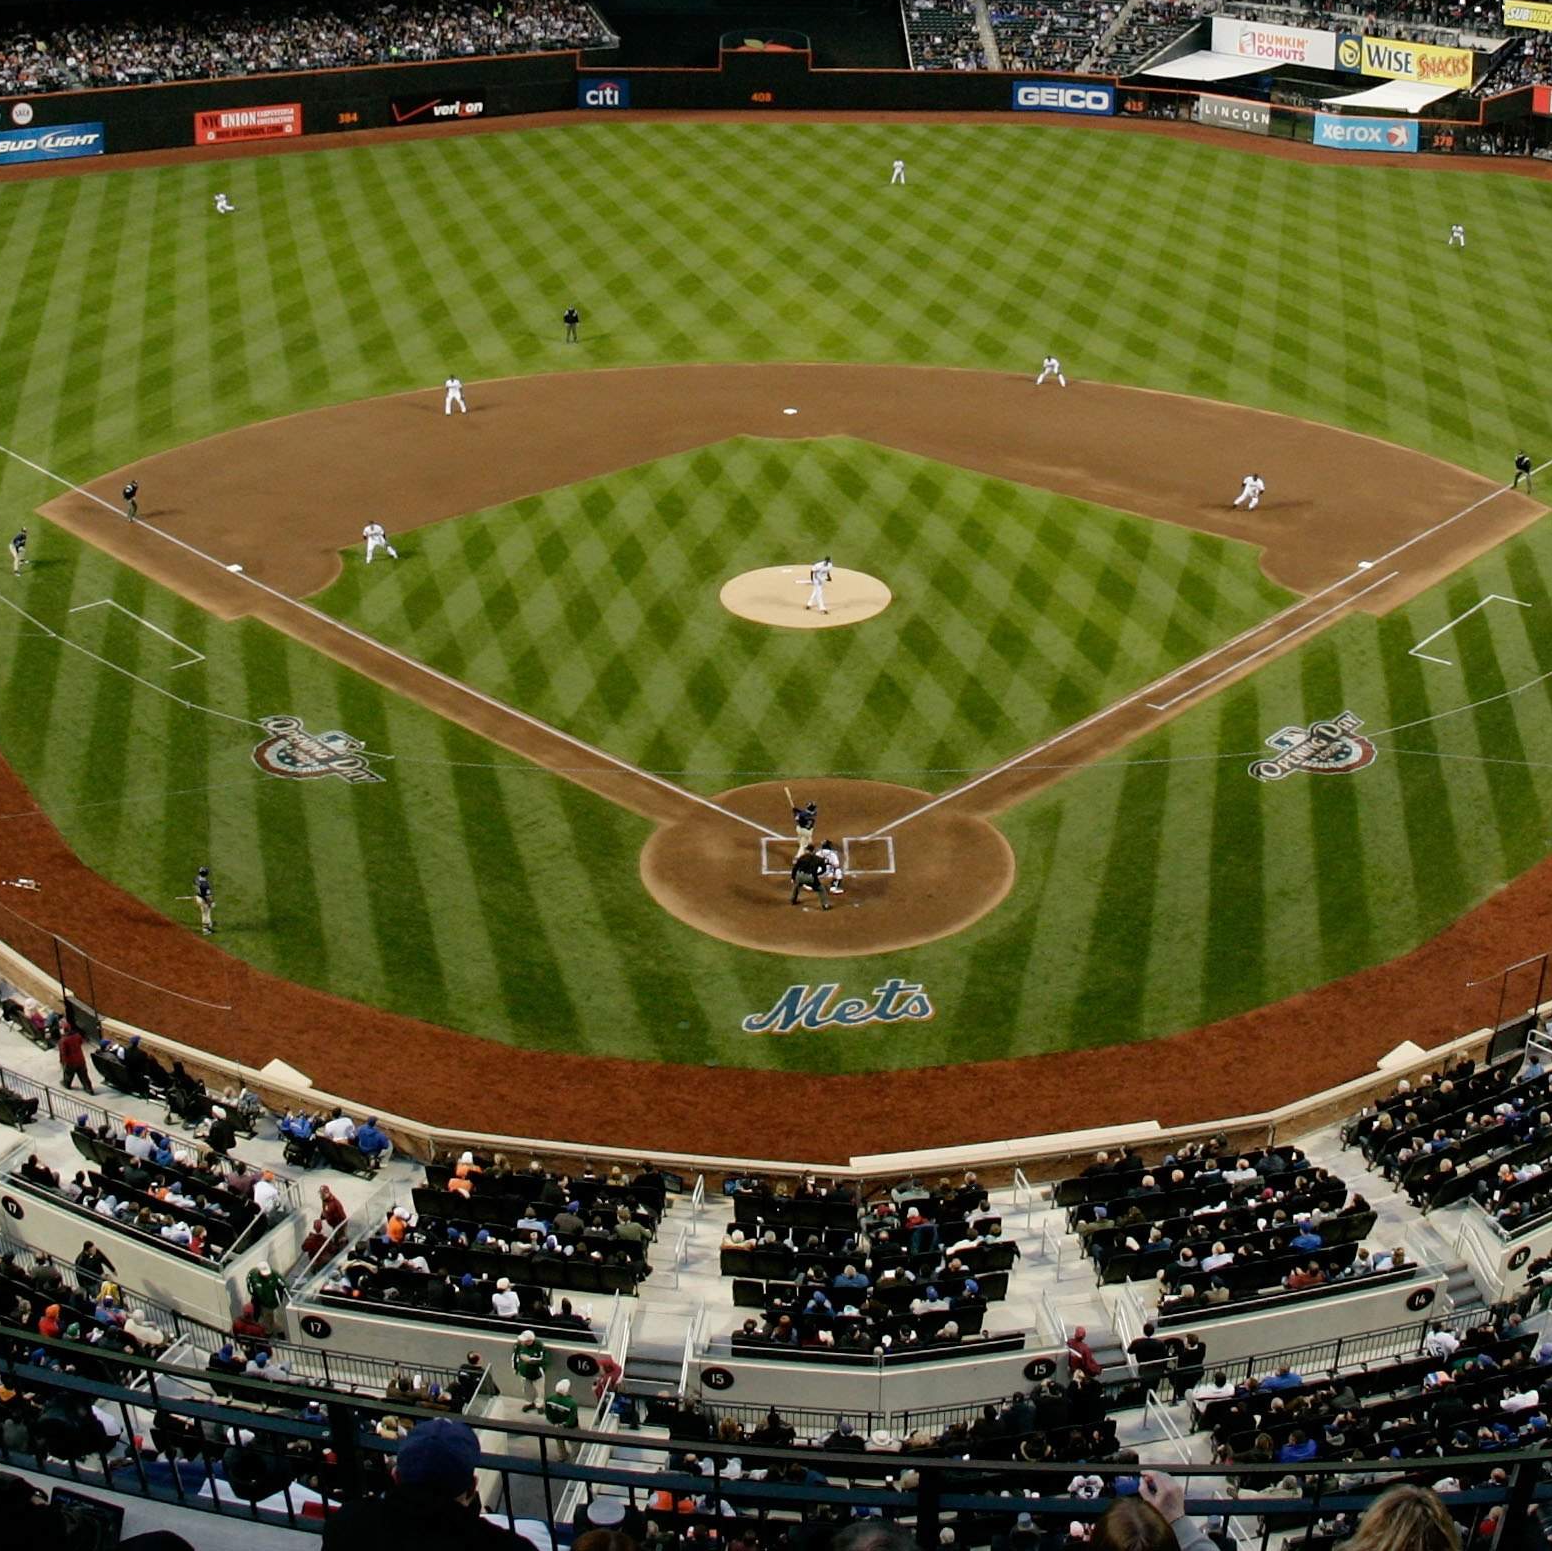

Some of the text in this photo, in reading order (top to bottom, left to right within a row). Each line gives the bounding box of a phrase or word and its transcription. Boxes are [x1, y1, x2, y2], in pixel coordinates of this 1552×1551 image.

[1257, 32, 1309, 47] DUNKIN'
[1257, 45, 1306, 62] DONUTS
[1366, 44, 1469, 80] WISE SNACKS
[586, 86, 619, 106] citi
[1018, 86, 1109, 111] GEICO
[433, 101, 483, 116] verizon
[1205, 103, 1270, 125] LINCOLN
[221, 111, 257, 128] UNION
[45, 132, 99, 148] LIGHT
[1321, 123, 1382, 144] xerox
[1255, 714, 1360, 778] OPENING DAY
[742, 978, 933, 1034] Mets
[310, 1321, 322, 1333] 17
[578, 1360, 589, 1371] 16
[1034, 1364, 1046, 1375] 15
[712, 1373, 724, 1385] 15
